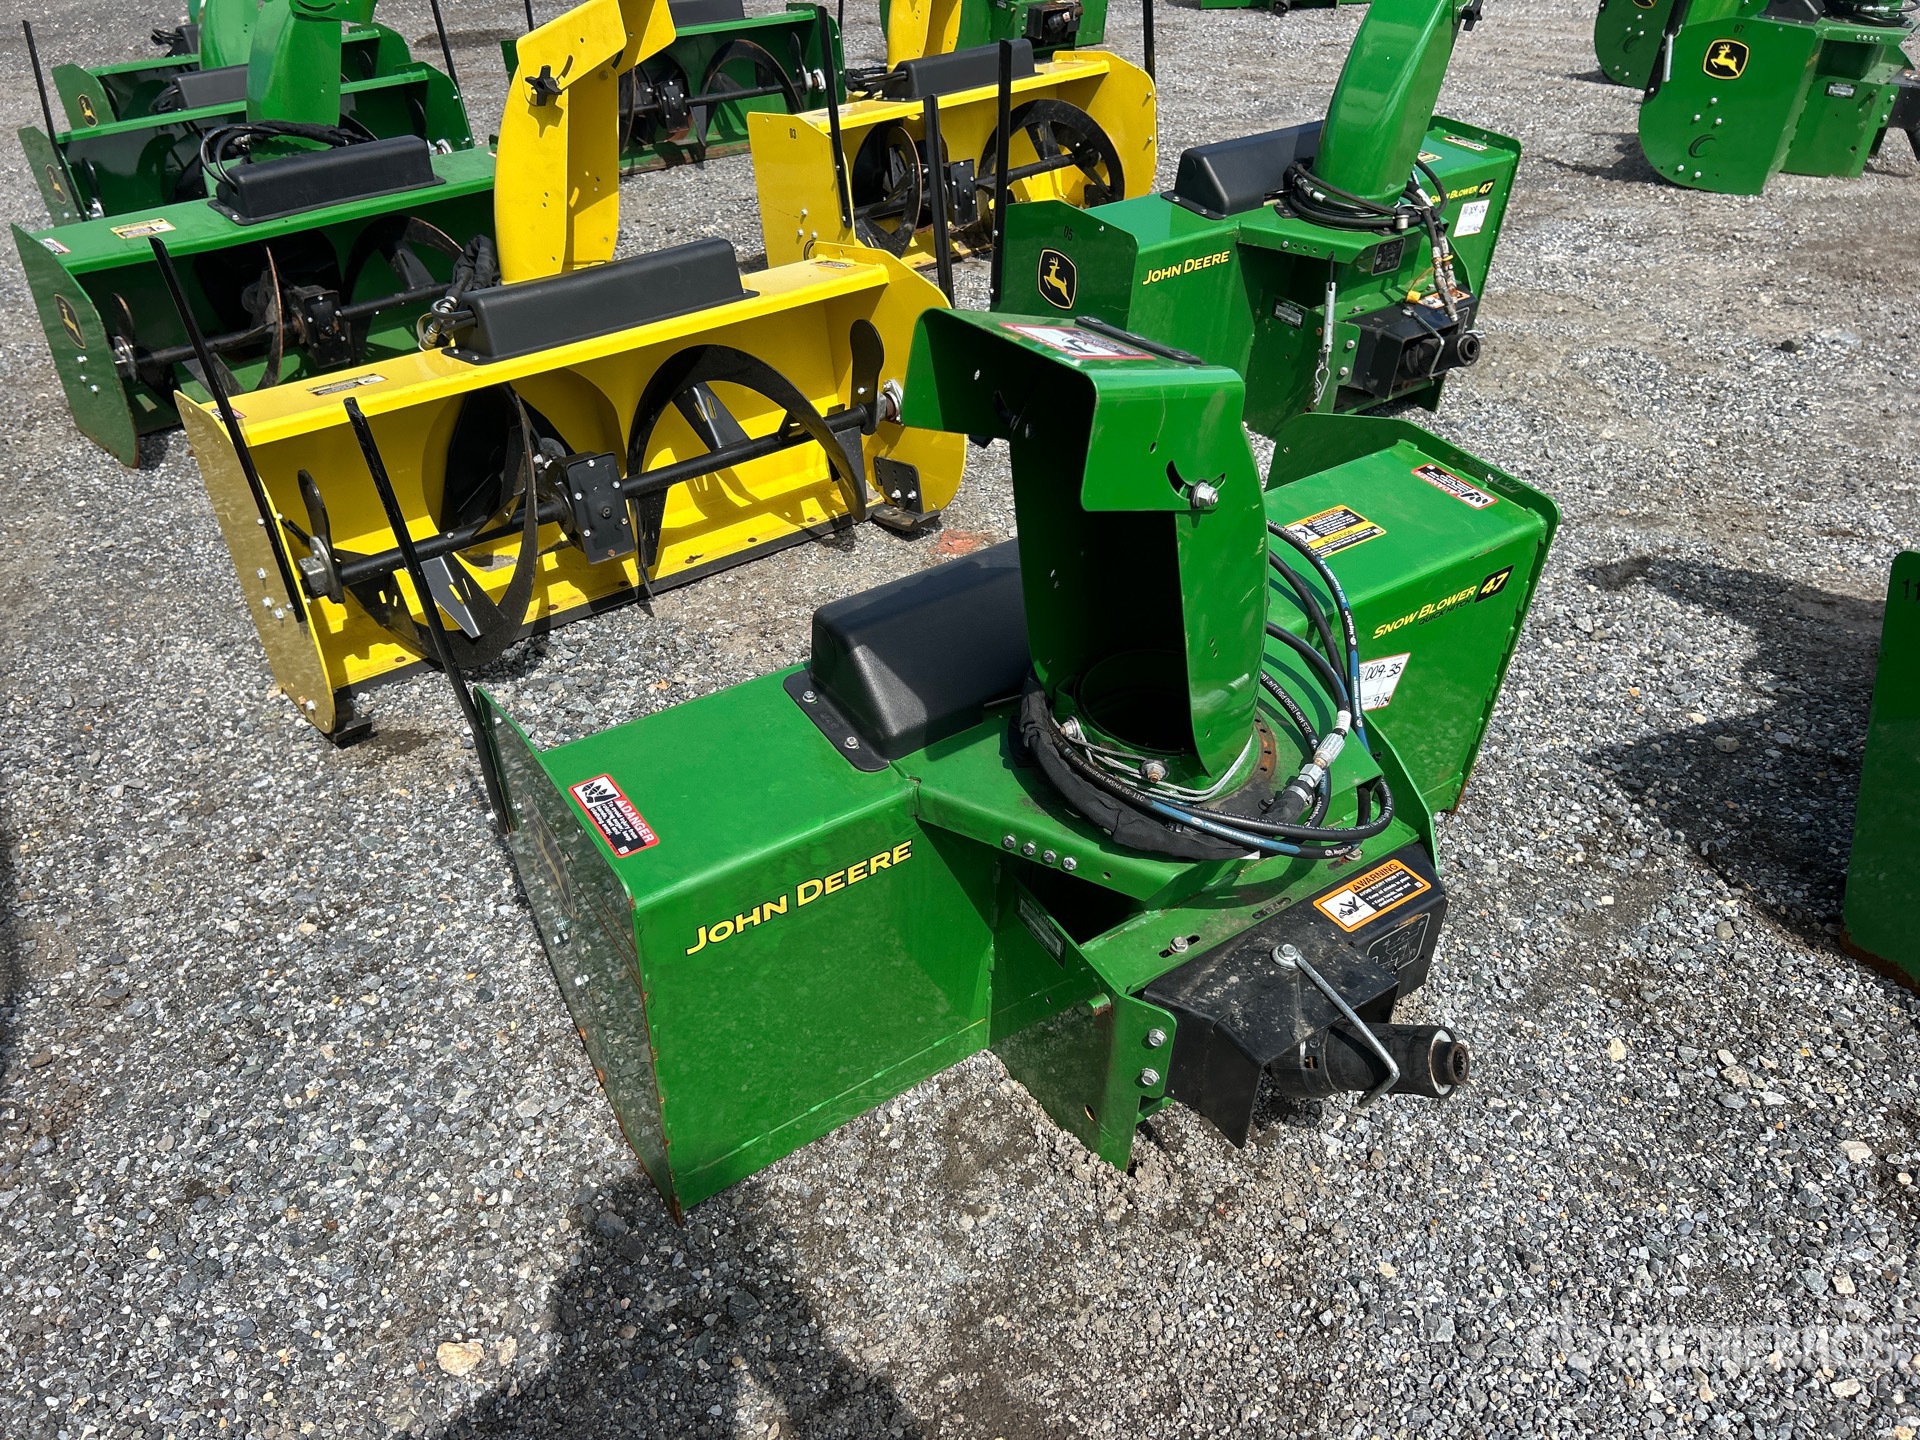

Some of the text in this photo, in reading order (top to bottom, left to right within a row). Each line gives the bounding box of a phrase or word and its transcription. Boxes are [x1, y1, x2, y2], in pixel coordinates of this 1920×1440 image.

[1479, 181, 1493, 194] 47
[1142, 250, 1230, 285] JOHN DEERE
[1372, 571, 1509, 639] SNOW BLOWER 47
[1418, 598, 1471, 626] QUICK HITCH
[1083, 762, 1106, 781] Resistant
[1106, 778, 1122, 791] MSHA
[611, 806, 622, 818] avoid
[627, 828, 638, 839] from
[620, 804, 654, 843] DANGER
[1359, 863, 1399, 887] WARNING
[685, 838, 913, 957] JOHN DEERE
